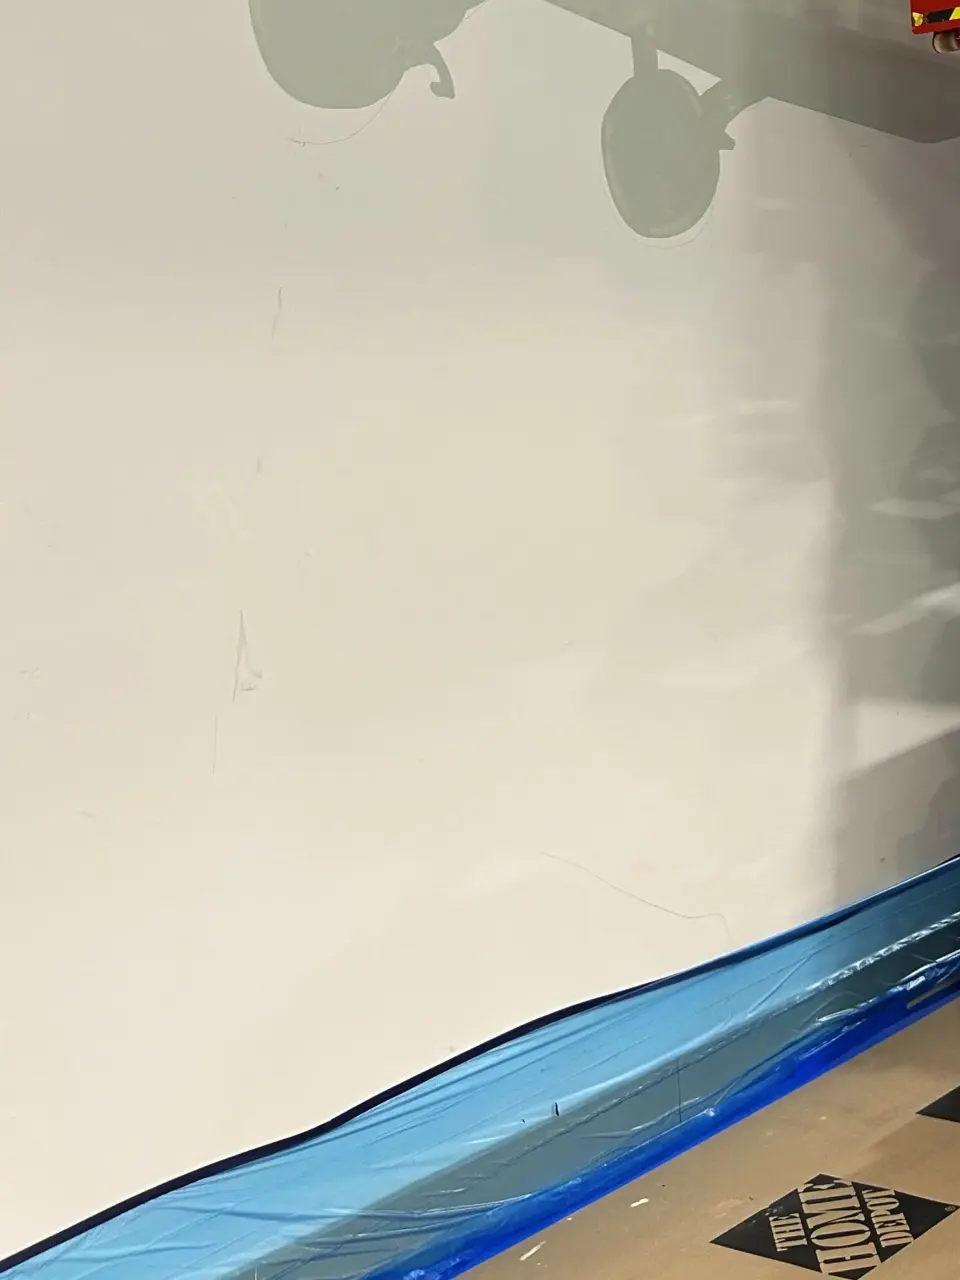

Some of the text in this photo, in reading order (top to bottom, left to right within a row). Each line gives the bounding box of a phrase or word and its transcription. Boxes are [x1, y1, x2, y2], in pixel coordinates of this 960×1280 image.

[769, 1213, 808, 1252] THE
[798, 1179, 880, 1274] HOME
[861, 1189, 914, 1248] DEPOT
